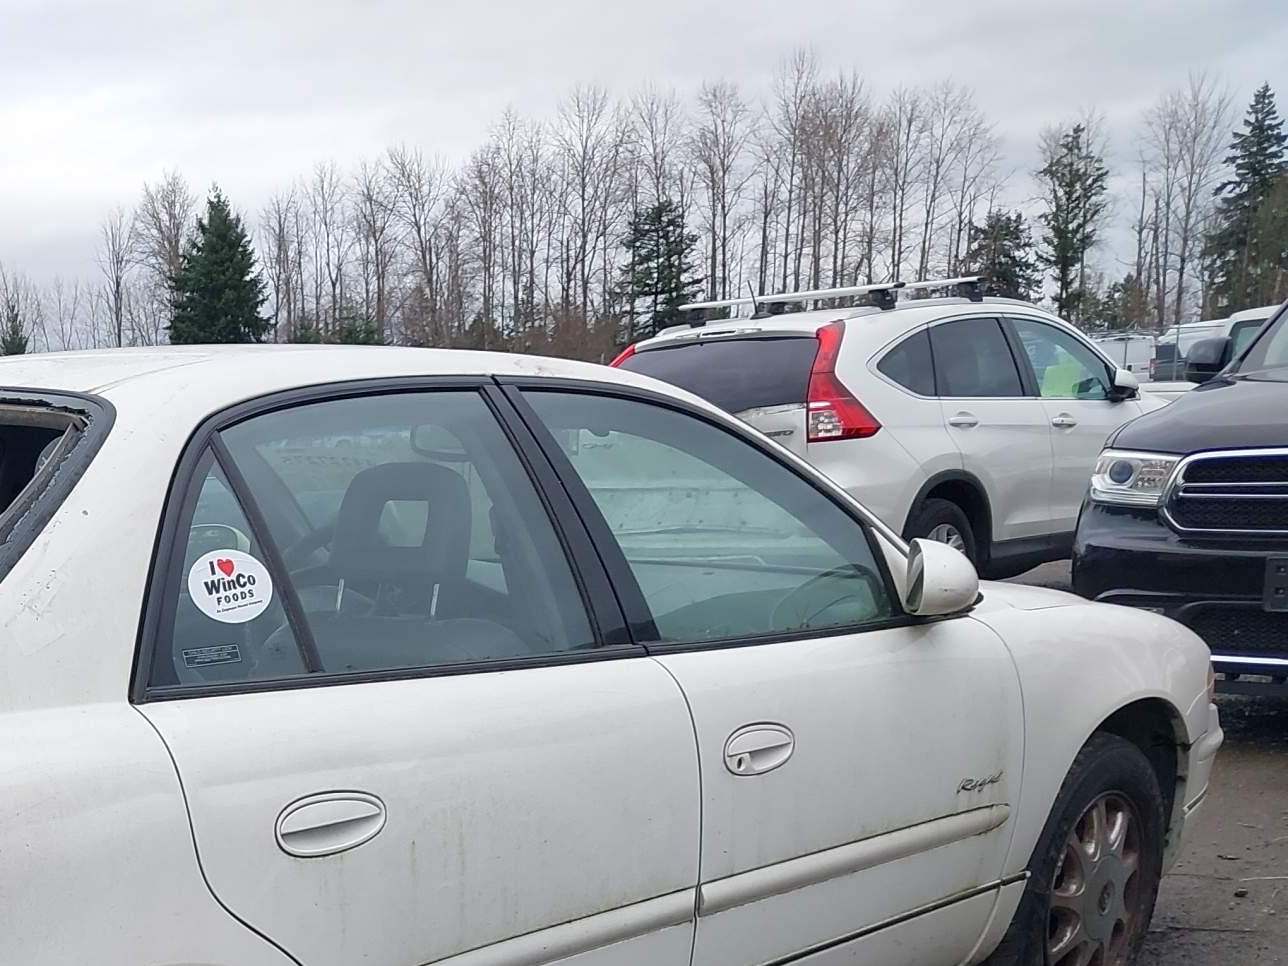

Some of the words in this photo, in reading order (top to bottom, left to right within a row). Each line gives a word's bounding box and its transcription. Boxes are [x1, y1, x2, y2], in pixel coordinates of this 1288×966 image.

[208, 561, 217, 576] I
[203, 573, 256, 596] WinCo
[216, 589, 255, 606] FOODS
